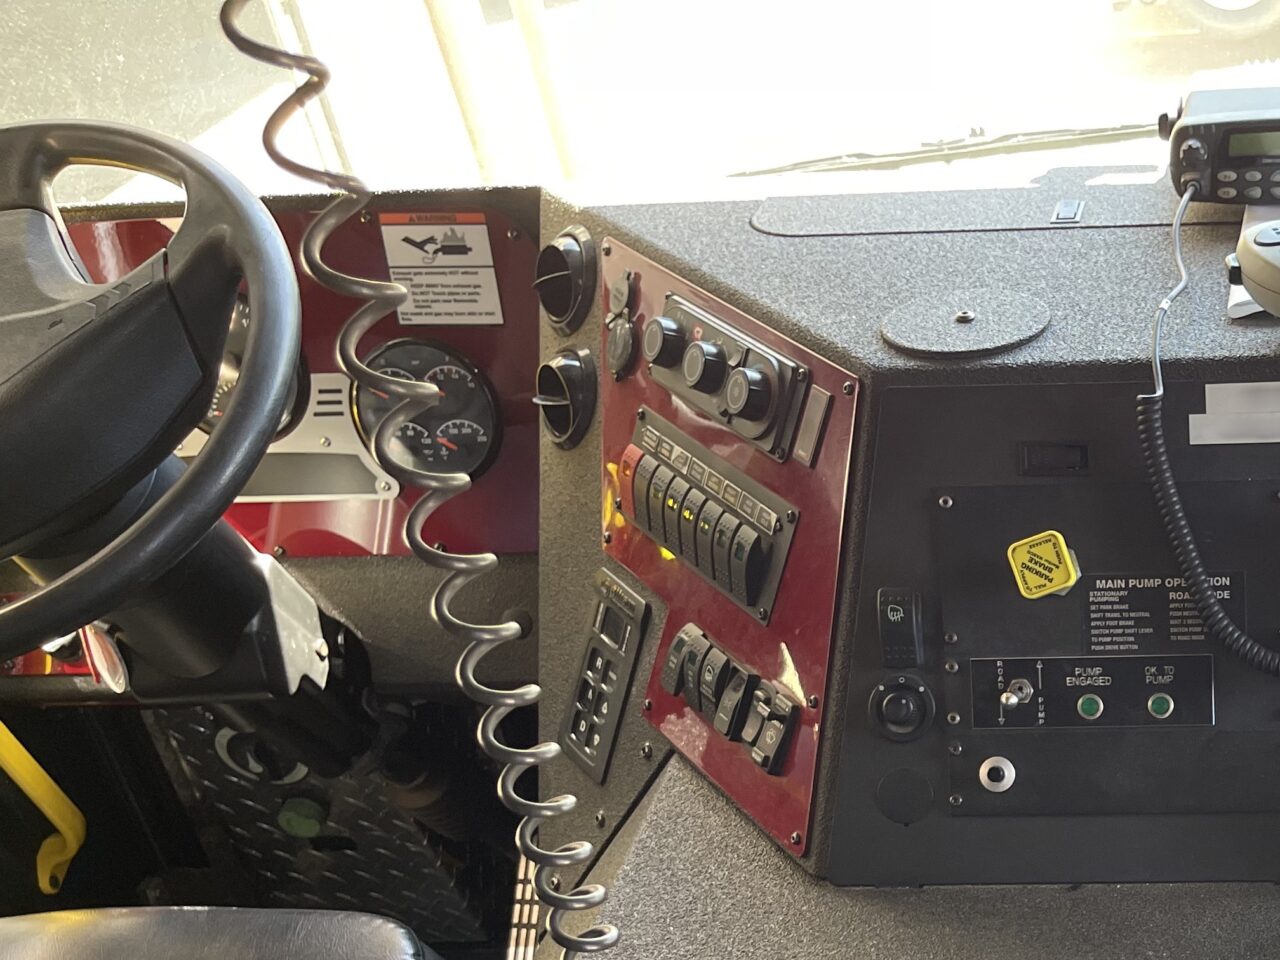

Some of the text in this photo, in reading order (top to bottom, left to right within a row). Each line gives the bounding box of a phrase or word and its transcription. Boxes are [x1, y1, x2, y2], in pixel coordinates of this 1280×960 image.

[1028, 557, 1053, 573] BRAKE
[1020, 562, 1053, 583] PARKING
[1096, 576, 1230, 589] MAIN PUMP OPETION
[1169, 592, 1192, 600] ROA
[996, 660, 1004, 690] ROAD
[1074, 667, 1103, 677] PUMP
[1144, 666, 1175, 676] OK TO
[1066, 676, 1112, 686] ENGAGED
[1146, 675, 1174, 684] PUMP
